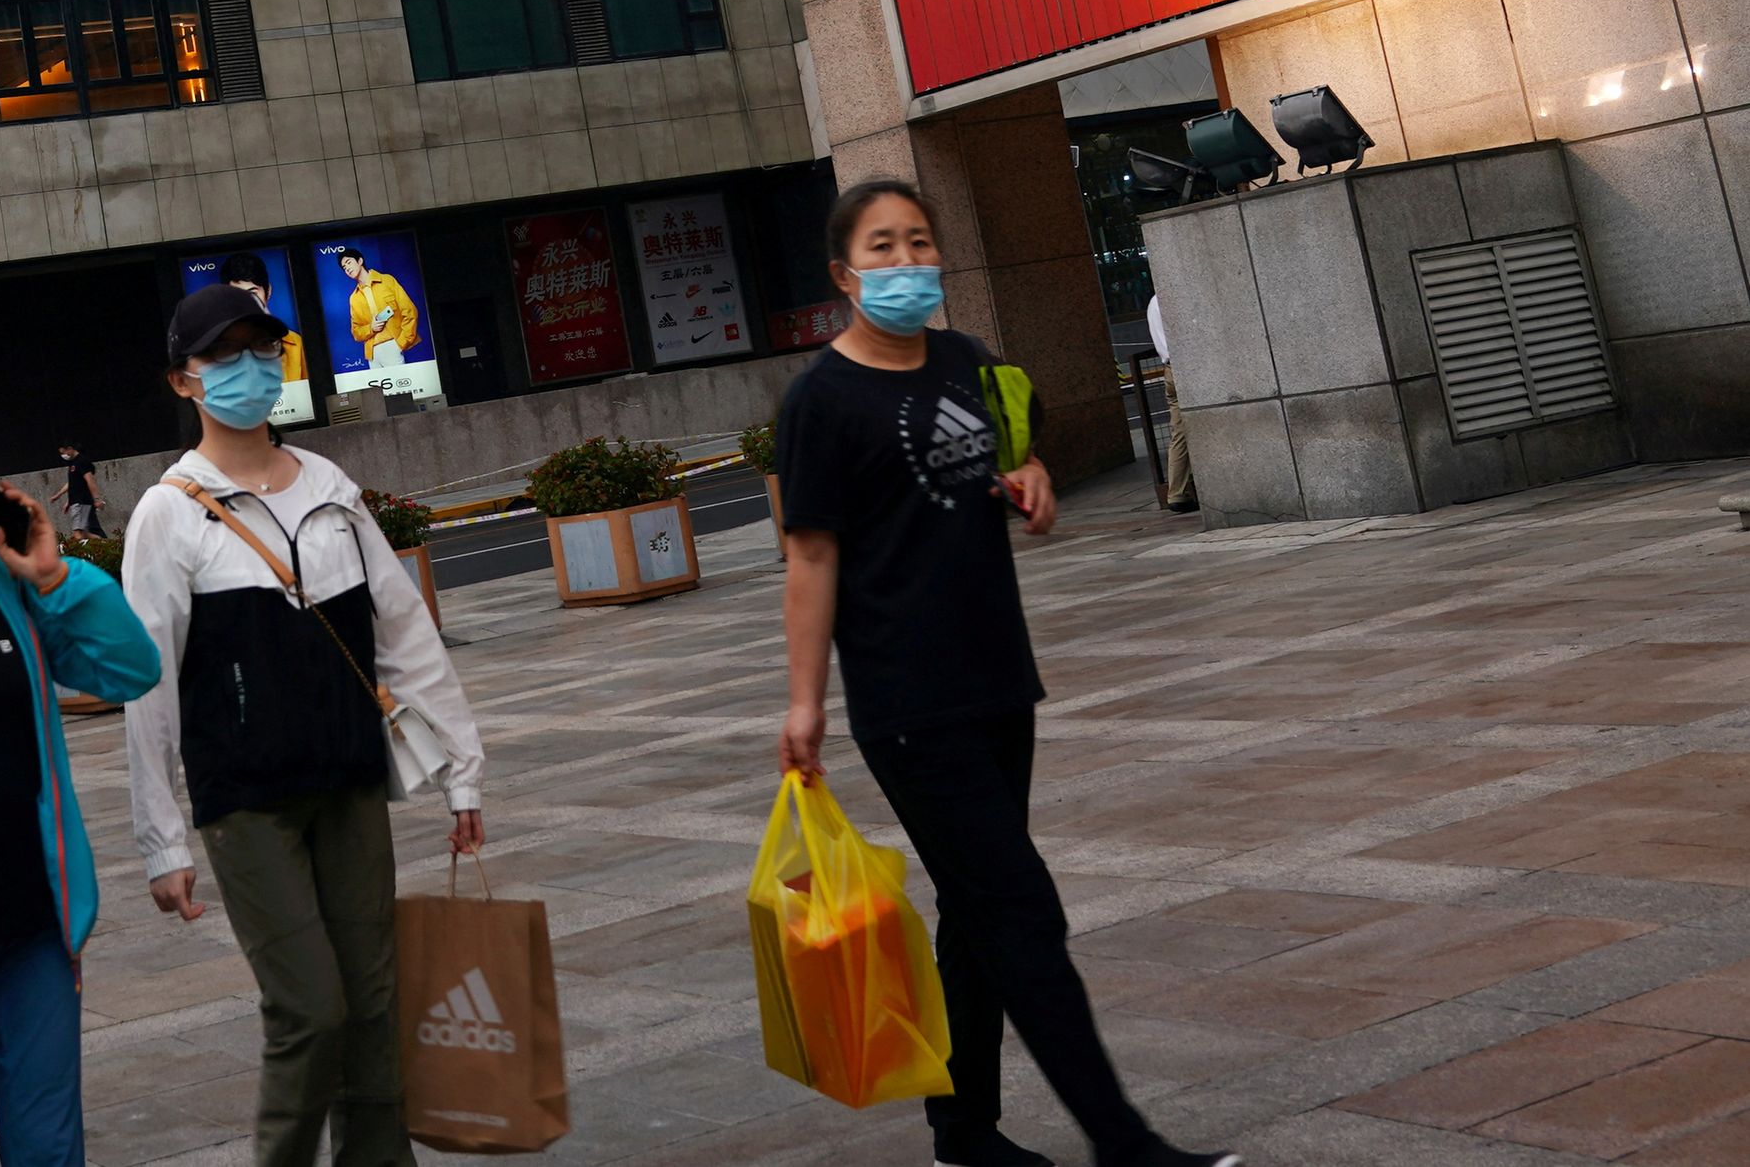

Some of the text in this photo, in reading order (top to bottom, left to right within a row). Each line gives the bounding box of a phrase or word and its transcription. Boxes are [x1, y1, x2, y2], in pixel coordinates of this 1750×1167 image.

[662, 210, 697, 229] 永兴
[320, 245, 346, 255] vivo
[542, 238, 579, 267] 永兴
[643, 225, 724, 258] 奥特莱斯
[188, 262, 216, 272] vivo
[524, 259, 611, 305] 奥特莱斯
[418, 1017, 516, 1054] adidas
